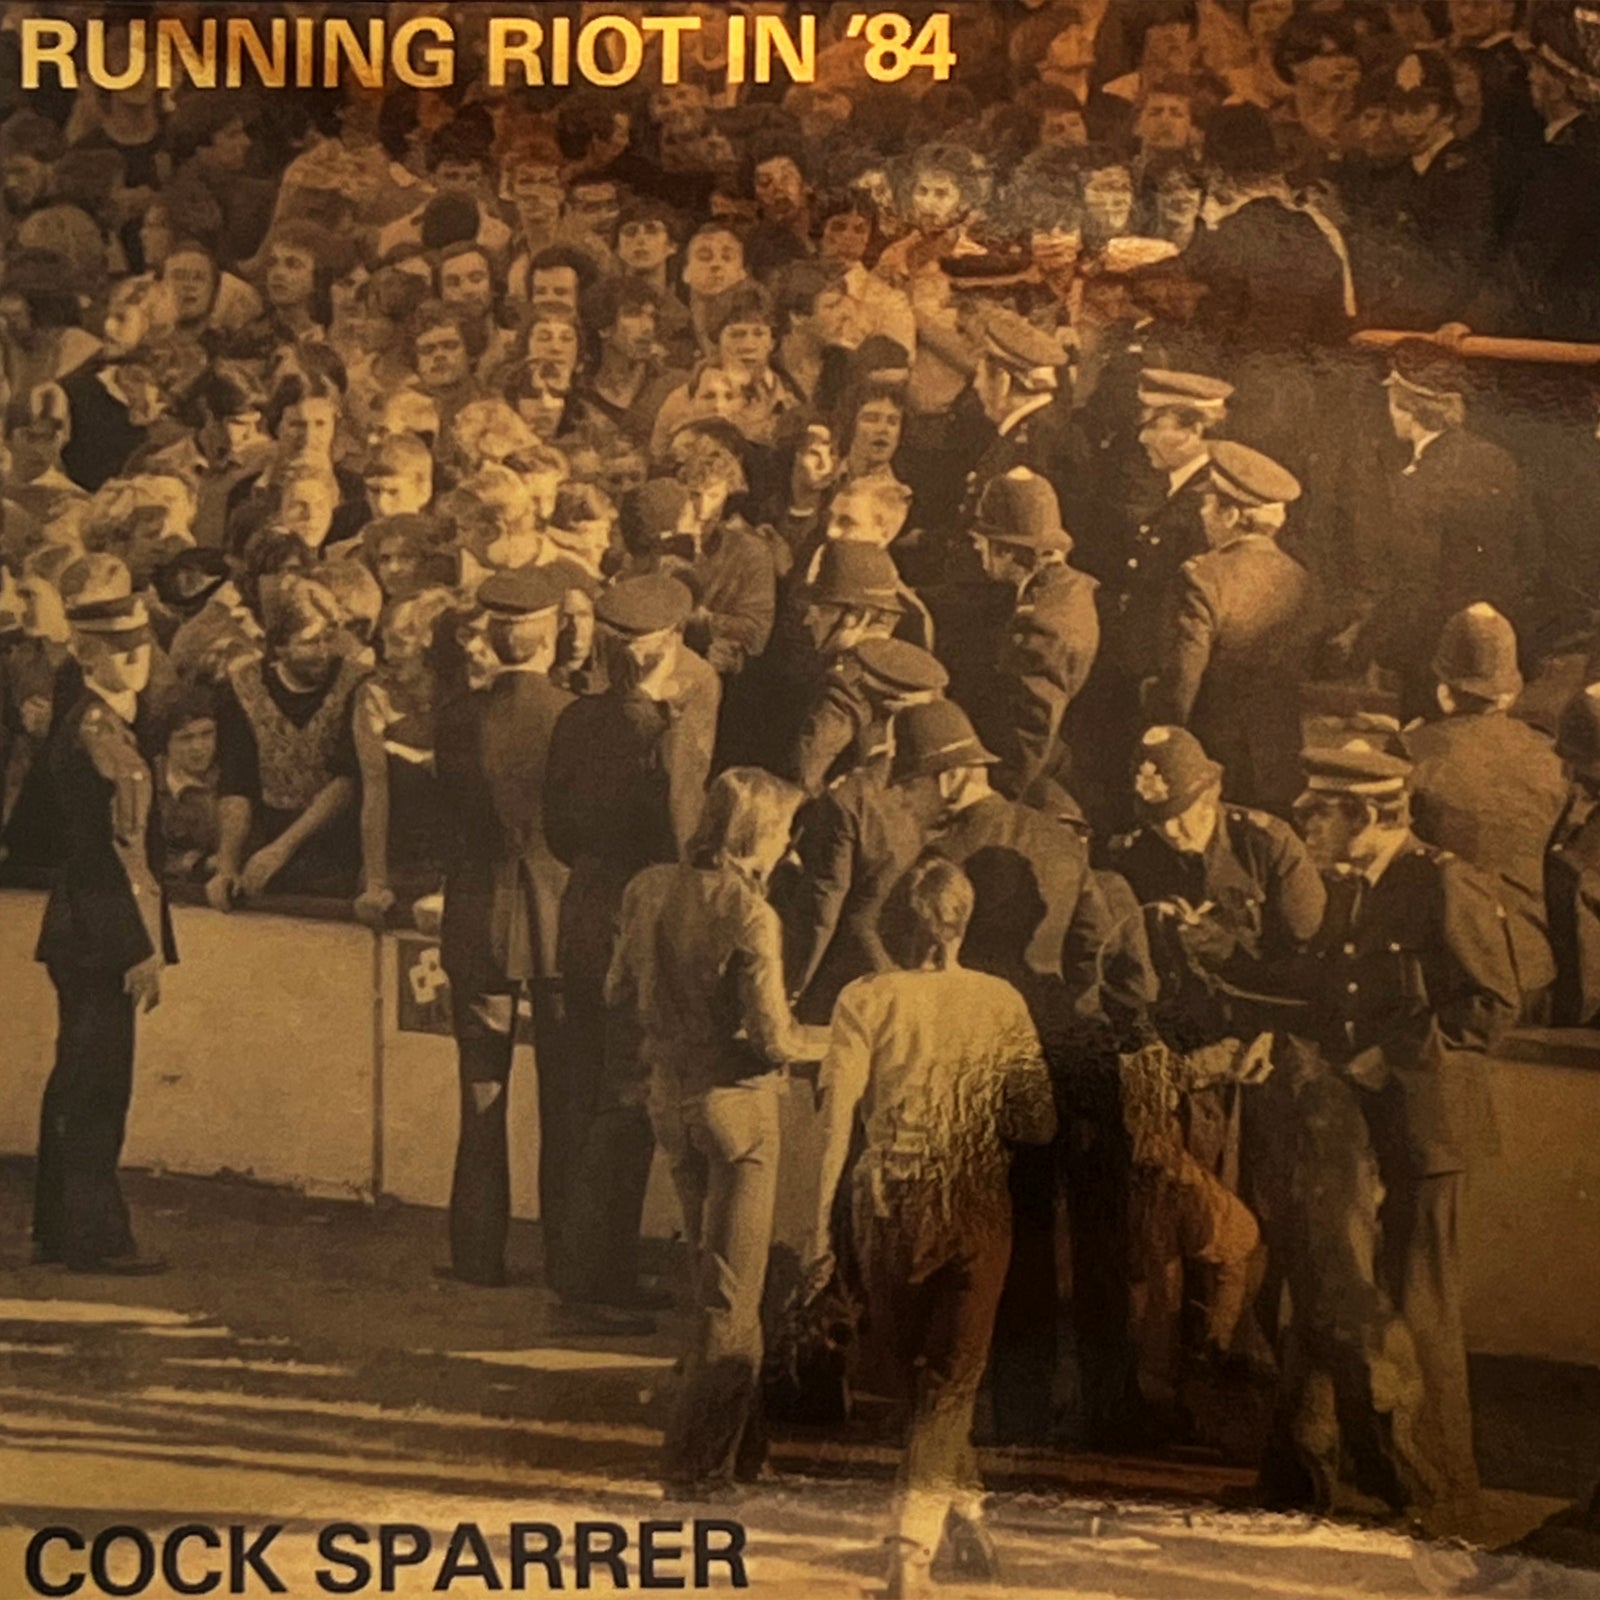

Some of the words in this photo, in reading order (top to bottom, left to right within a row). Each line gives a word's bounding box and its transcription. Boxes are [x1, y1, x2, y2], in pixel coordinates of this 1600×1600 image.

[21, 16, 456, 90] RUNNING
[488, 15, 701, 86] RIOT
[728, 14, 815, 84] IN
[847, 12, 957, 83] '84
[25, 1523, 288, 1597] COCK
[315, 1519, 749, 1593] SPARRER
